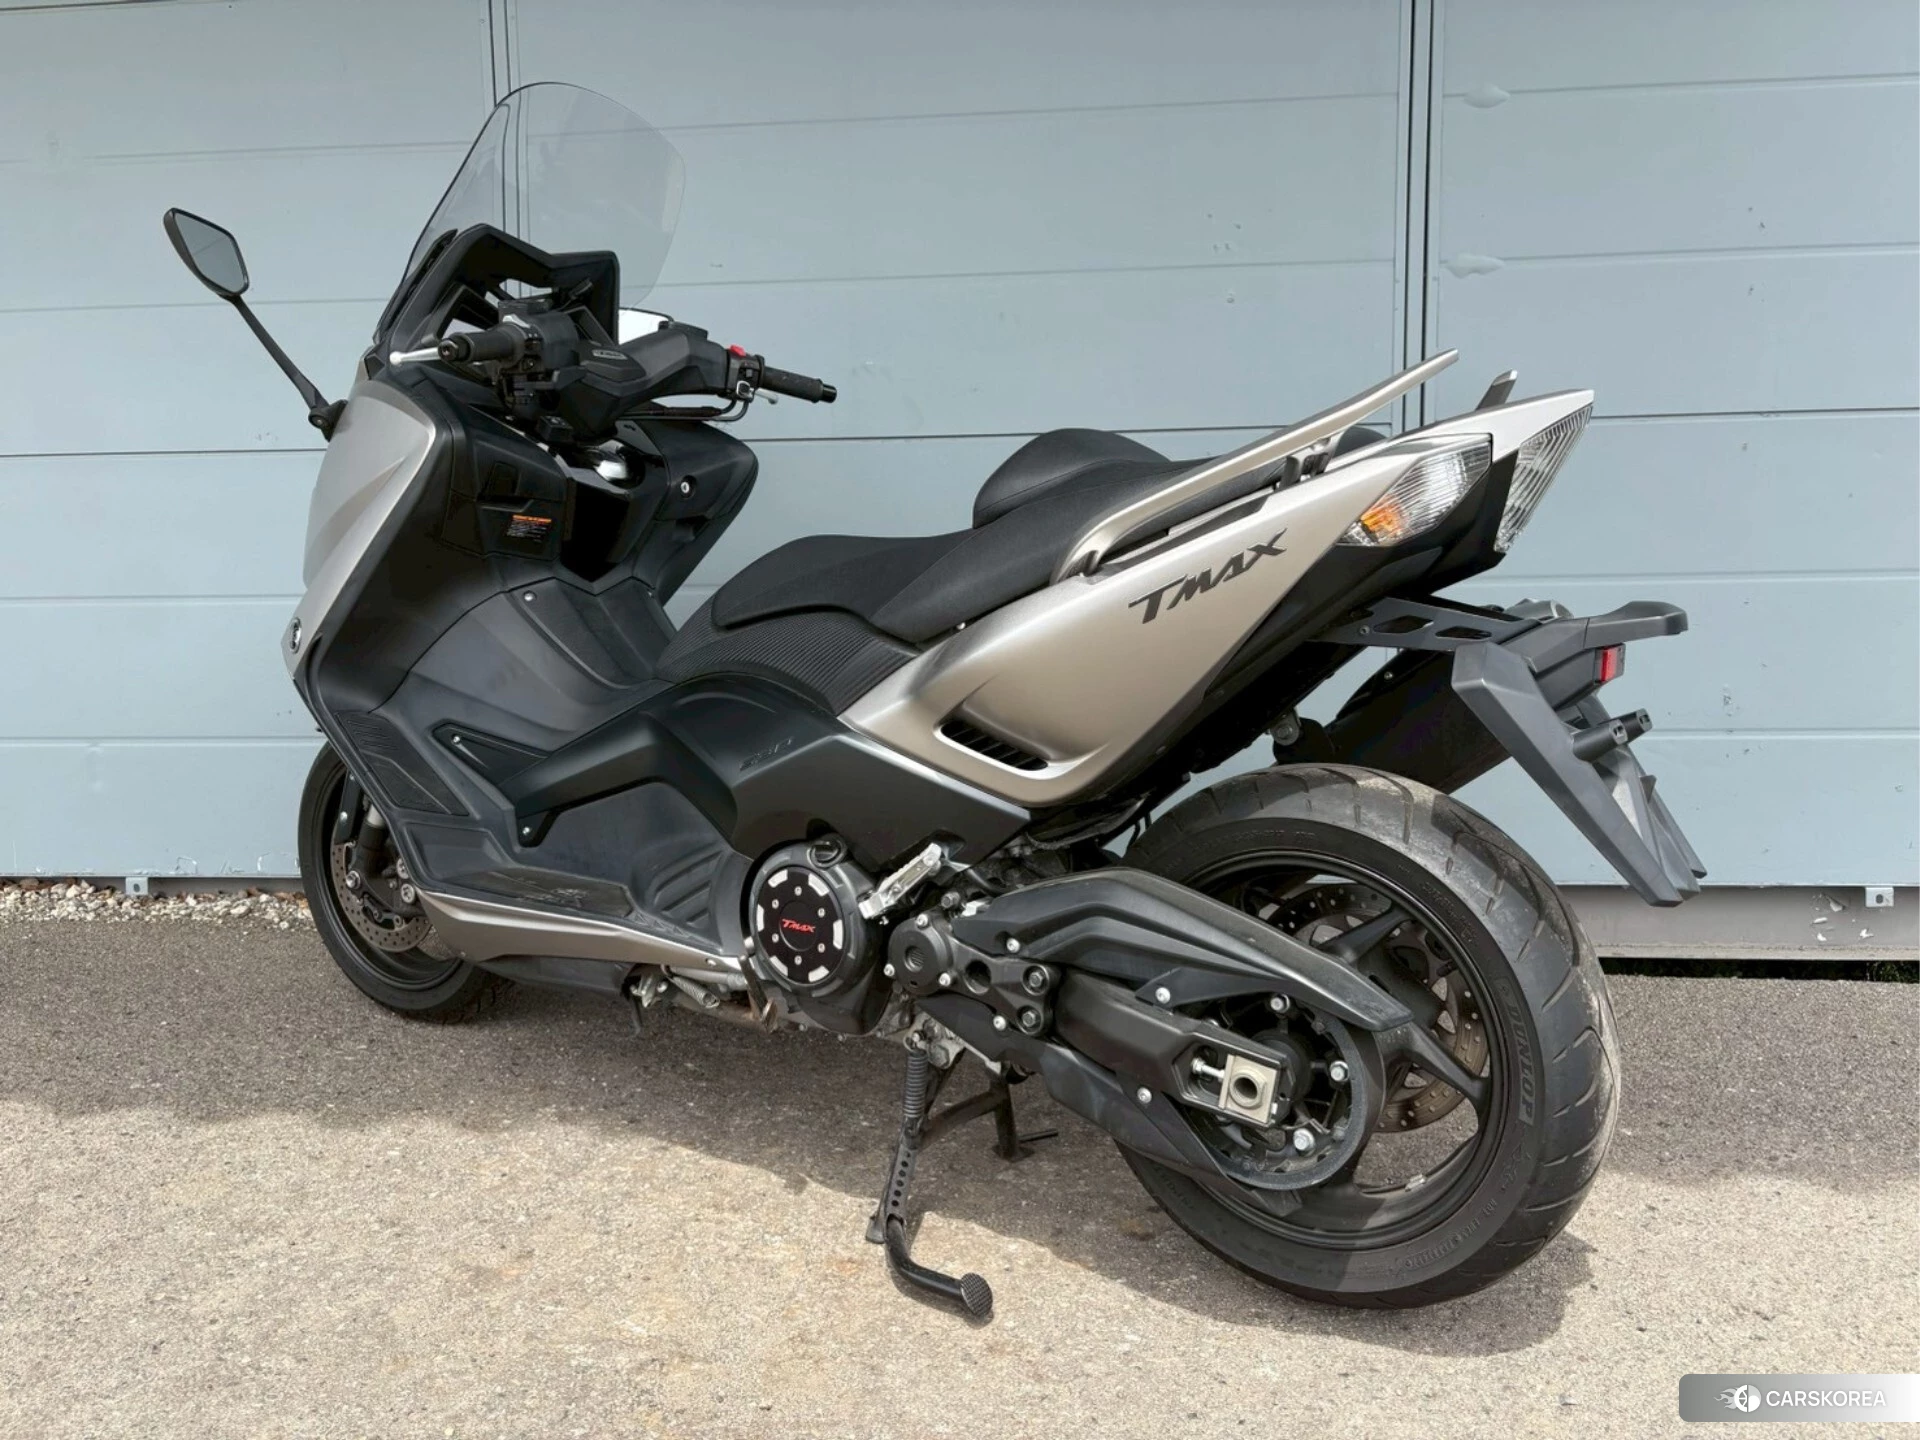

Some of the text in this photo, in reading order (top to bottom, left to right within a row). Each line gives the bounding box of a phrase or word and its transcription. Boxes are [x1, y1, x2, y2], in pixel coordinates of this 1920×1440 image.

[1128, 528, 1287, 624] TMAX
[782, 918, 815, 933] TMAX
[1509, 1004, 1535, 1120] DUNLOP
